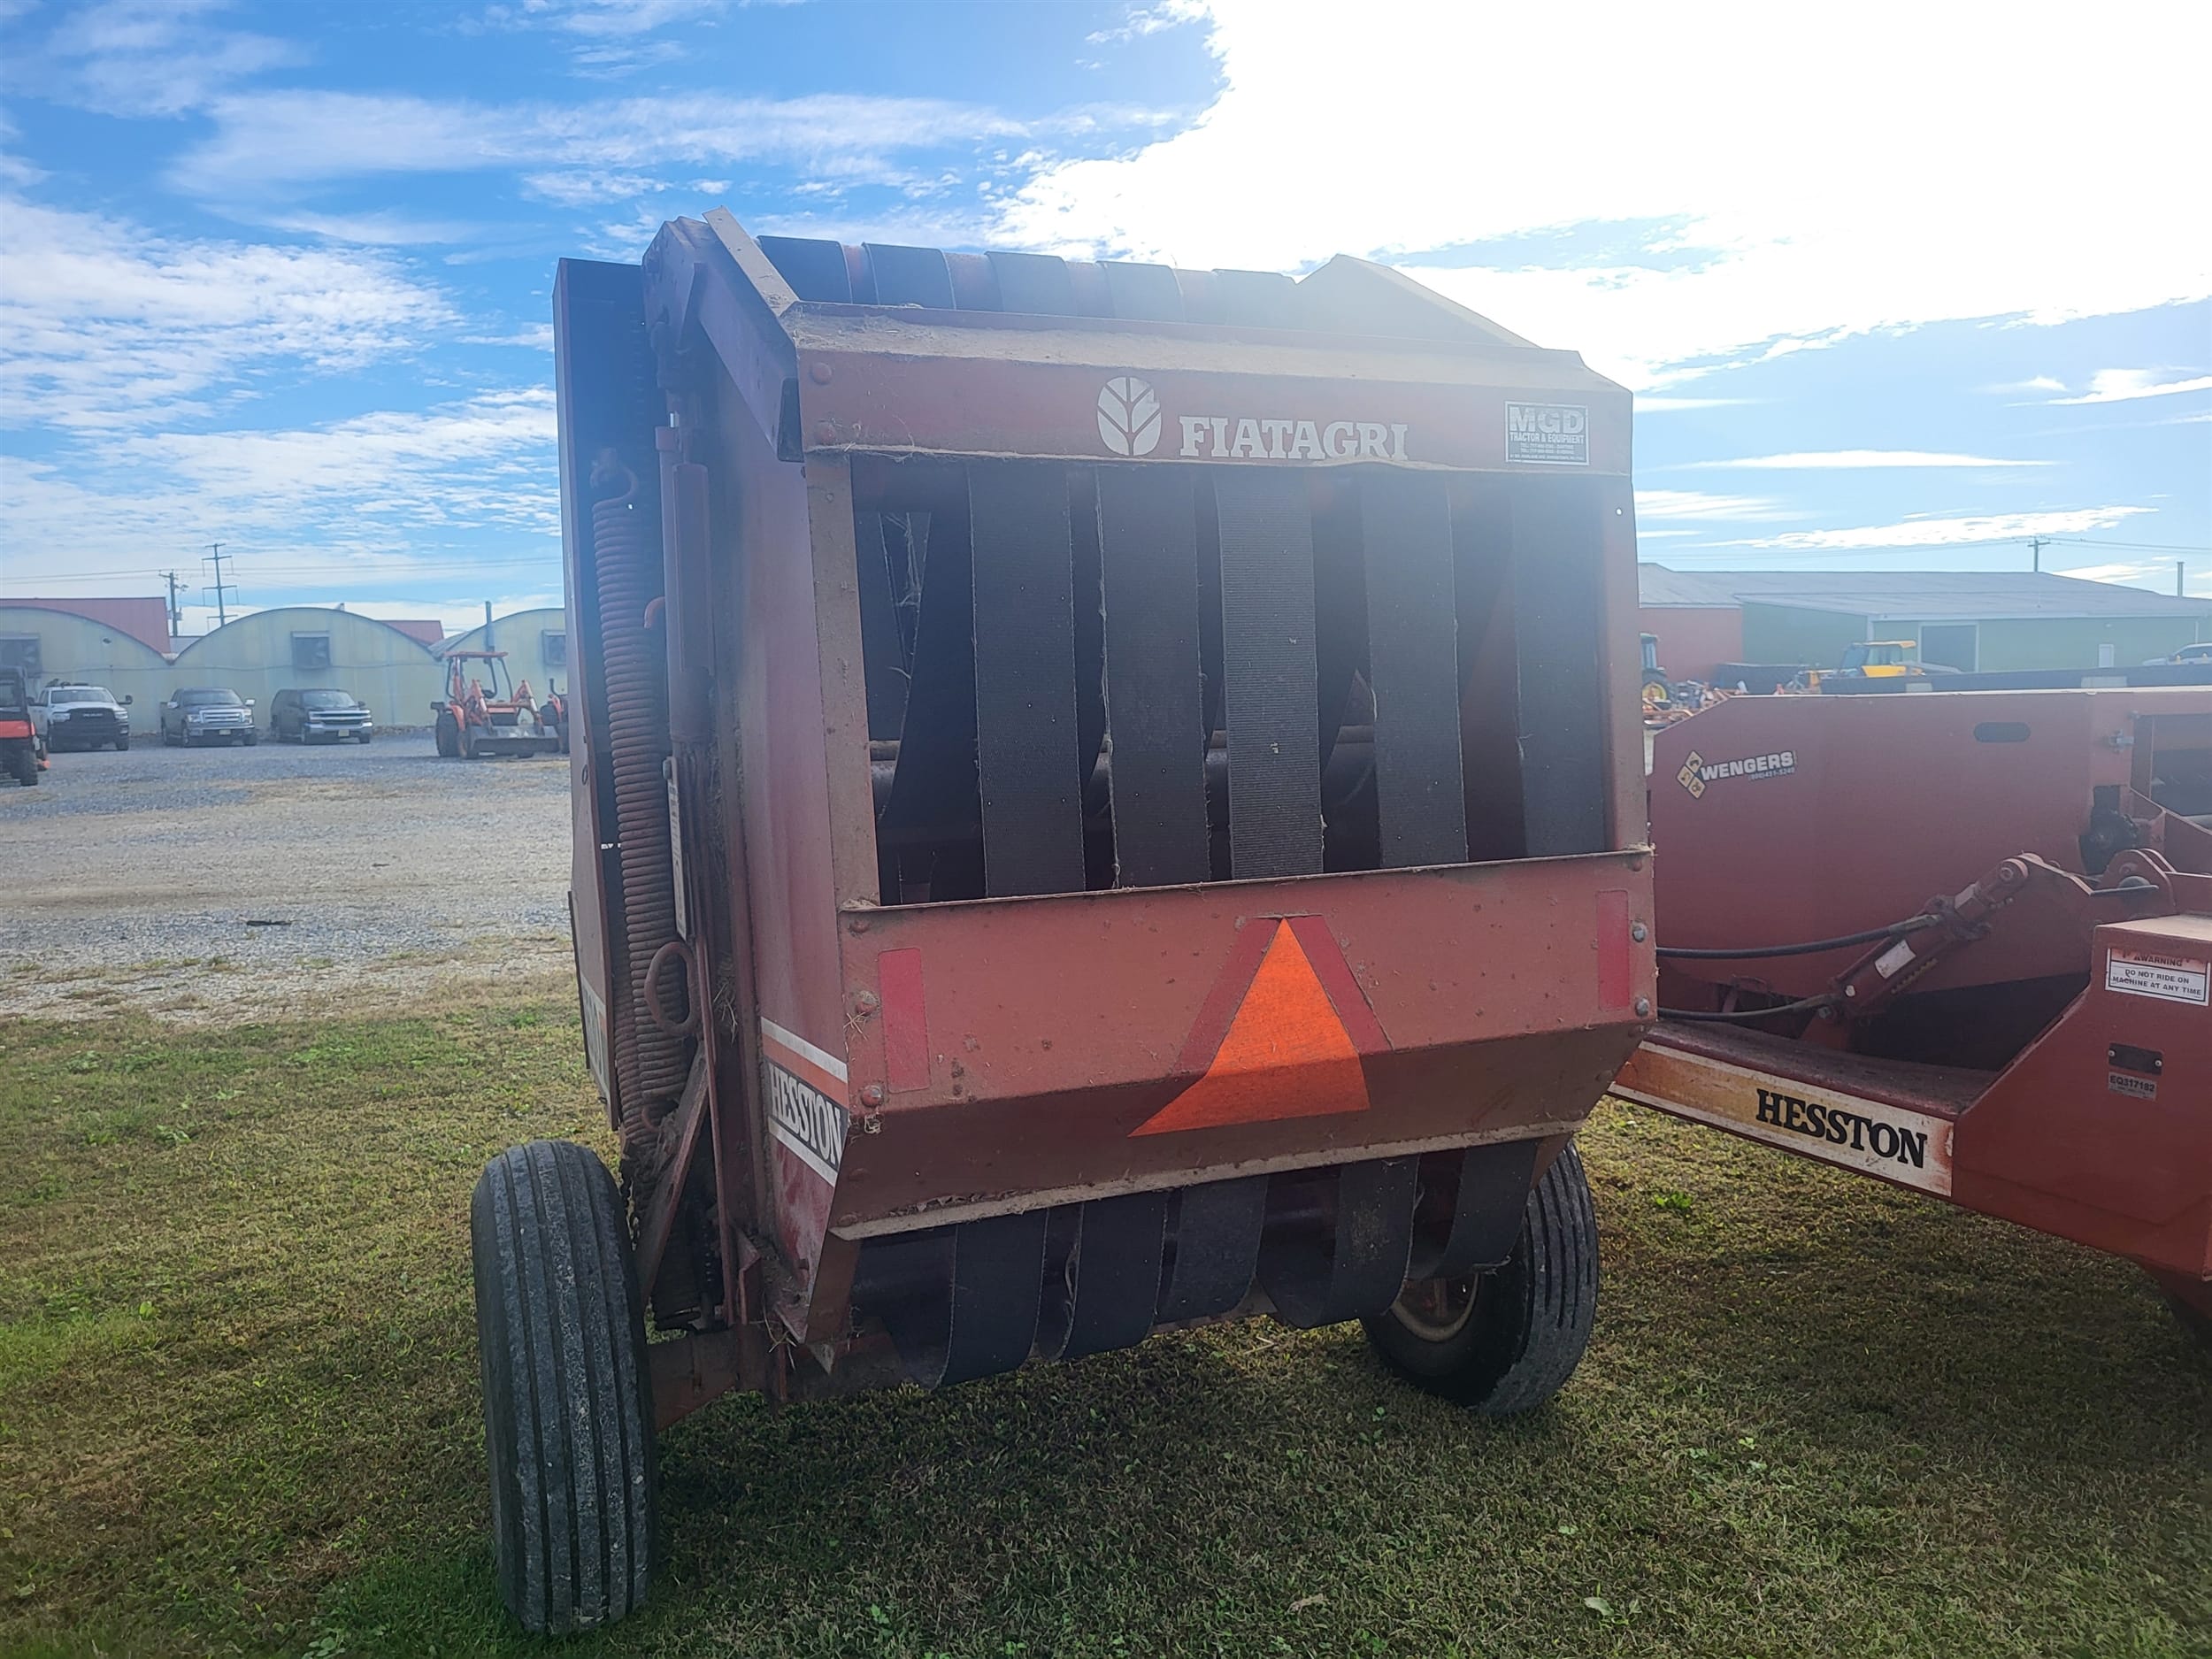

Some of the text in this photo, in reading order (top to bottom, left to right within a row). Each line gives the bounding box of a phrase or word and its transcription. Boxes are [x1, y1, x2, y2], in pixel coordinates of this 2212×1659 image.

[1509, 407, 1584, 434] MGD
[1179, 415, 1409, 461] FIATAGRI
[1509, 431, 1540, 442] TRACTOR
[1700, 751, 1794, 781] WENGERS
[2139, 956, 2183, 967] WARNING
[2112, 976, 2148, 987] MACHINE
[2182, 987, 2202, 995] TIME
[2156, 973, 2175, 982] RIDE
[768, 1062, 841, 1165] HESSTON
[1755, 1088, 1928, 1168] HESSTON
